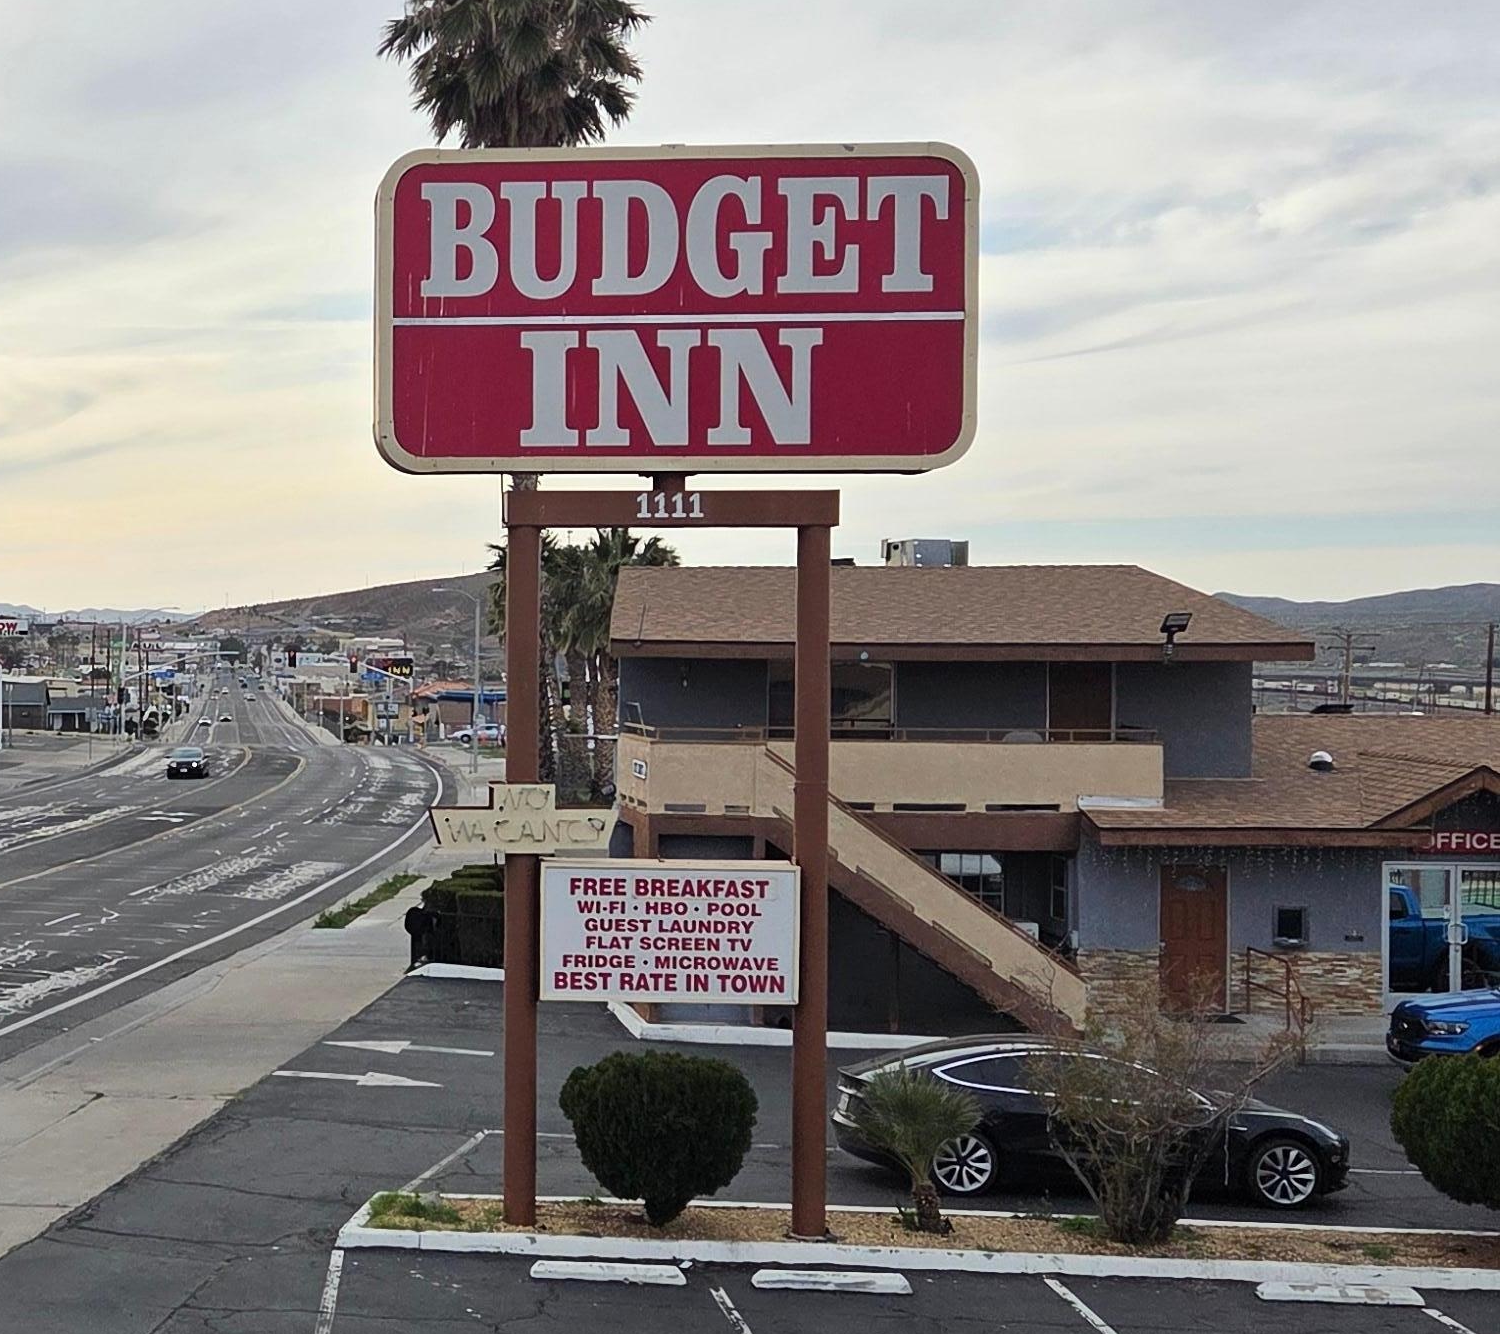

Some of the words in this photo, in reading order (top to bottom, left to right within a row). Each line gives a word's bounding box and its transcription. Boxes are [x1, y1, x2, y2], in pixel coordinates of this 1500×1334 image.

[419, 174, 950, 300] BUDGET
[520, 327, 824, 447] INN
[636, 492, 704, 518] 1111
[503, 788, 550, 810] NO
[569, 878, 627, 896] FREE
[634, 878, 770, 899] BREAKFAST
[577, 900, 626, 914] WI-FI
[645, 901, 688, 915] HBO
[707, 902, 762, 916] POOL
[584, 918, 652, 932] GUEST
[658, 919, 754, 934] LAUNDRY
[586, 936, 633, 949] FLAT
[639, 936, 720, 951] SCREEN
[727, 938, 752, 951] TV
[562, 954, 636, 968] FRIDGE
[654, 956, 779, 971] MICROWAVE
[554, 971, 612, 990] BEST
[619, 972, 677, 991] RATE
[685, 973, 709, 992] IN
[716, 974, 785, 993] TOWN
